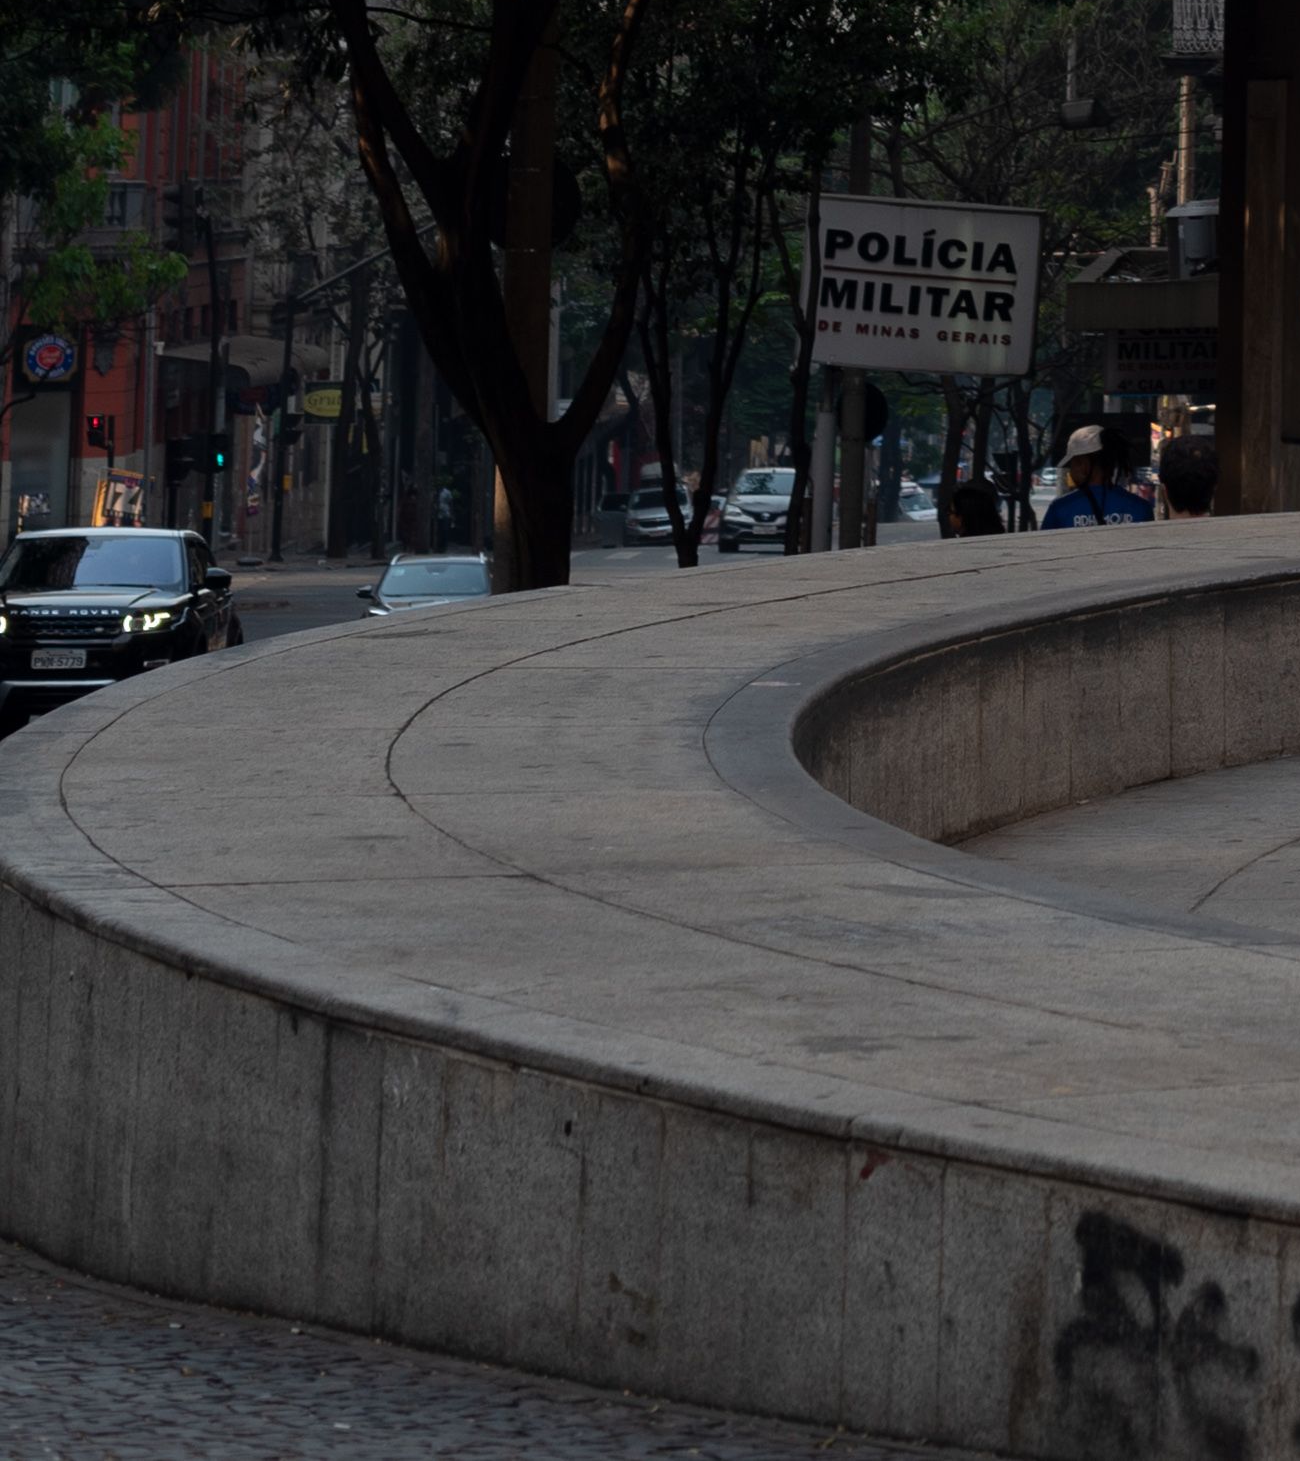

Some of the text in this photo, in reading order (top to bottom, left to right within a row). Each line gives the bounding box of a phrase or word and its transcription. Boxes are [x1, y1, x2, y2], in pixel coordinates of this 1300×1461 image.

[823, 229, 1017, 274] POLÍCIA
[820, 277, 1015, 322] MILITAR
[817, 320, 1012, 346] DE MINAS GERAIS
